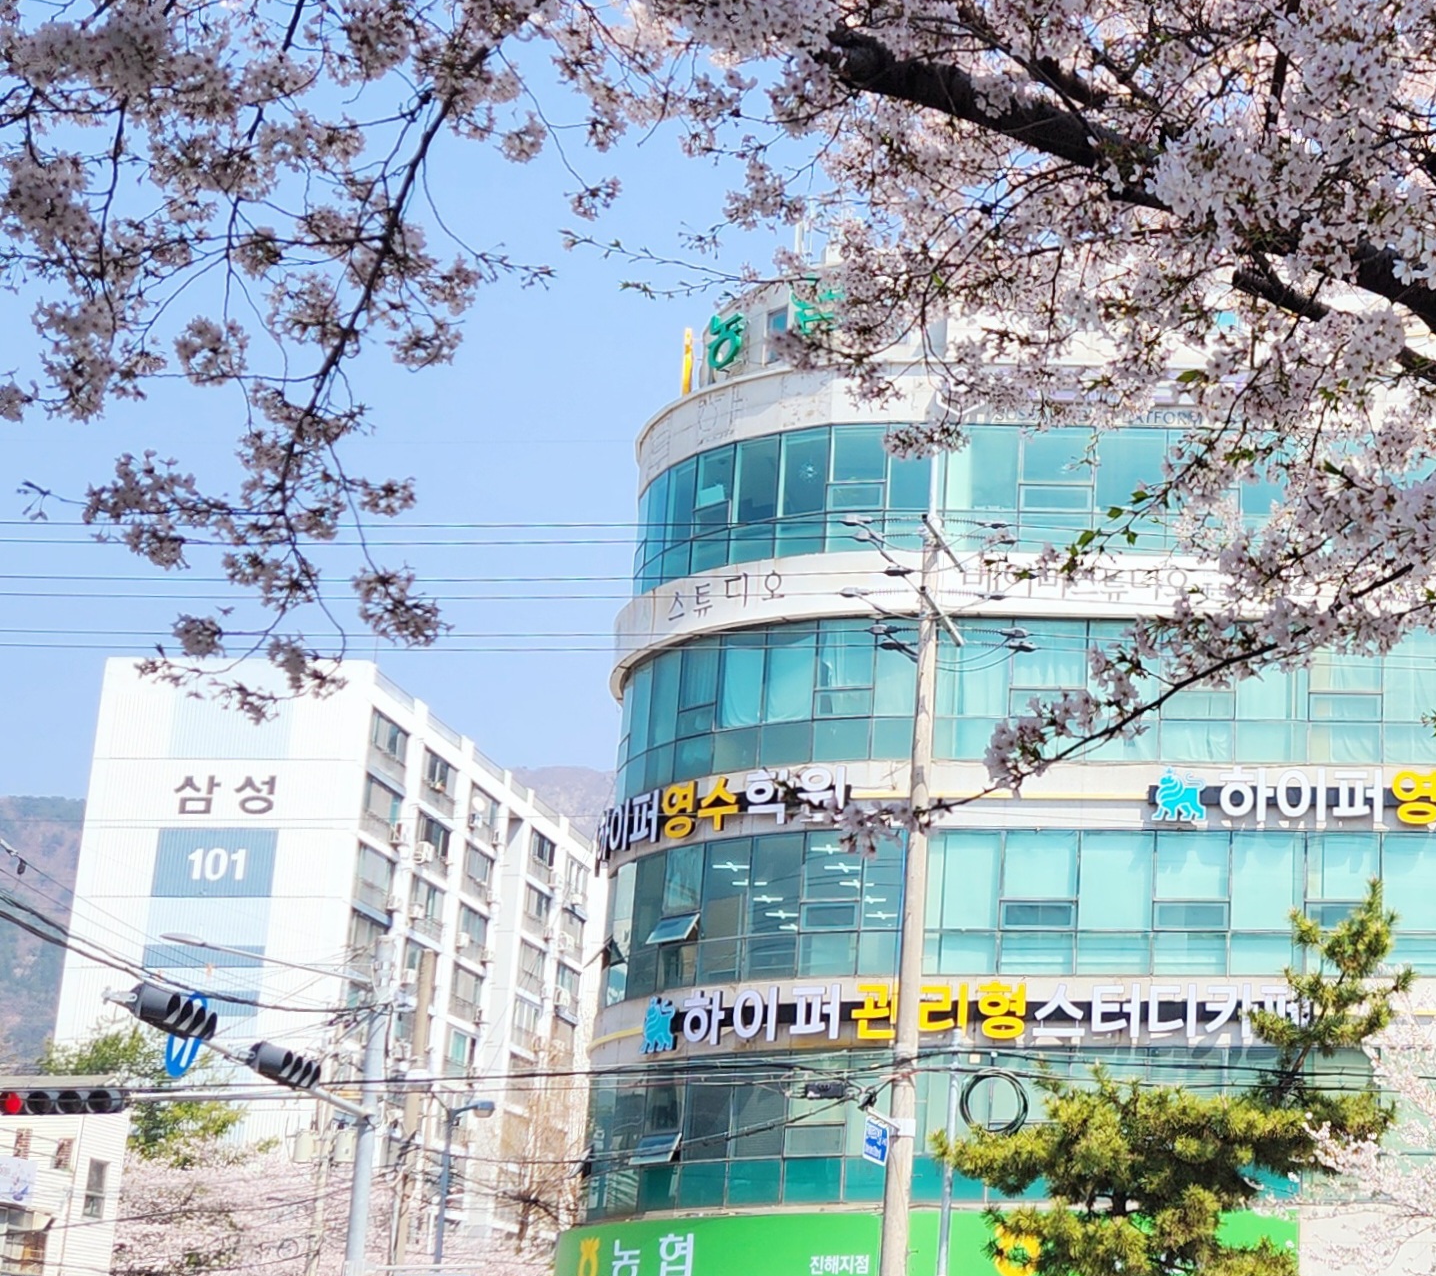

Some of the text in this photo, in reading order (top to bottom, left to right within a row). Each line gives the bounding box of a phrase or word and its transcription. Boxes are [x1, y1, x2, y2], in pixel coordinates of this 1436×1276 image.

[668, 569, 785, 621] 스튜디오
[173, 774, 278, 815] 삼성
[187, 846, 247, 882] 101
[808, 1254, 870, 1276] 진해지점
